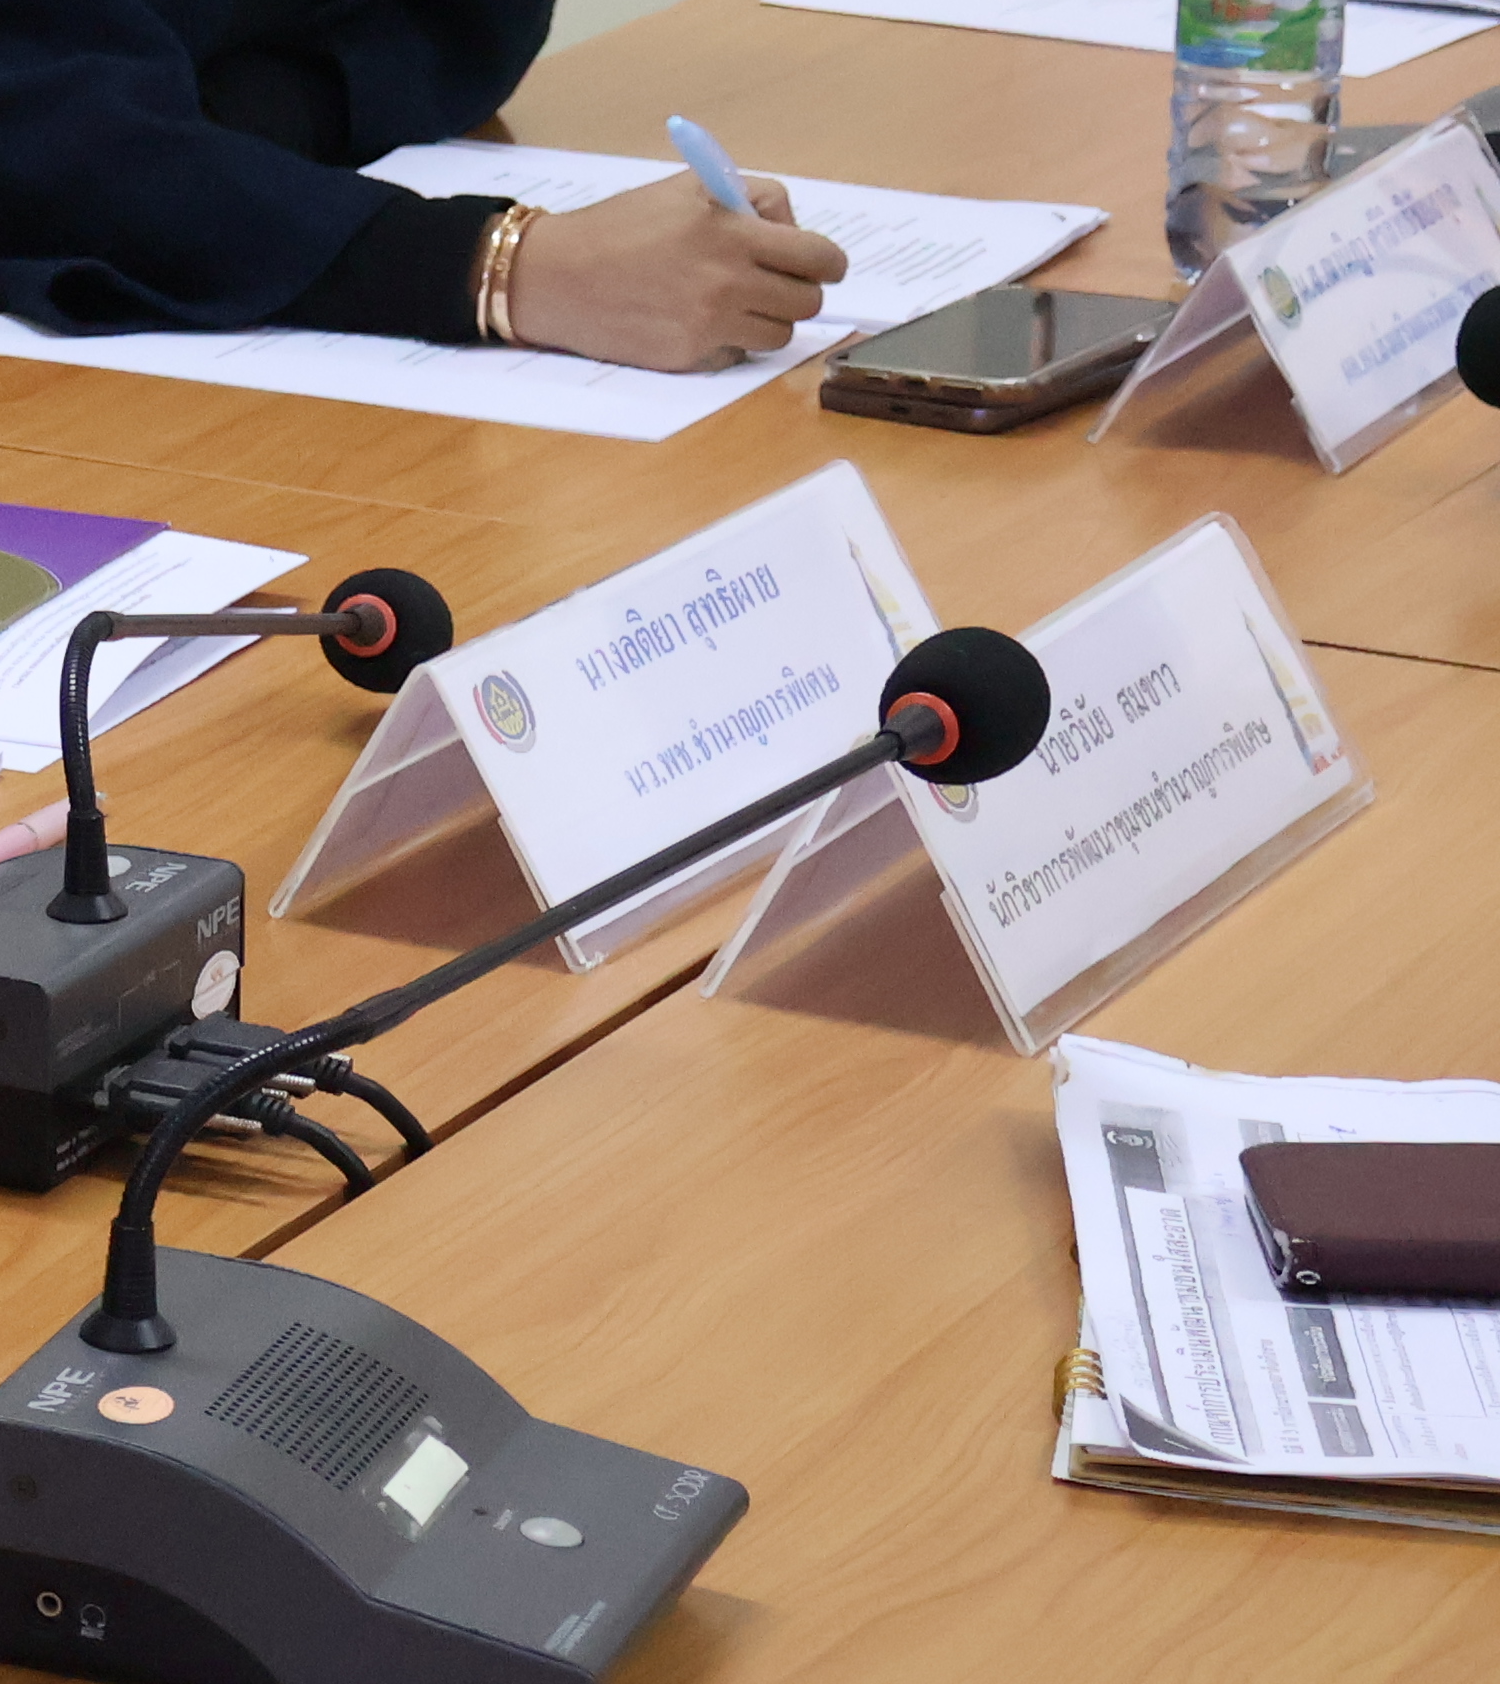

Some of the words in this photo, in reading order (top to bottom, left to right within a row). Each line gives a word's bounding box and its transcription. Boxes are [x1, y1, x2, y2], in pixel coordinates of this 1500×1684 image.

[124, 861, 188, 894] NPE
[196, 895, 240, 946] NPE
[27, 1366, 96, 1413] NPE
